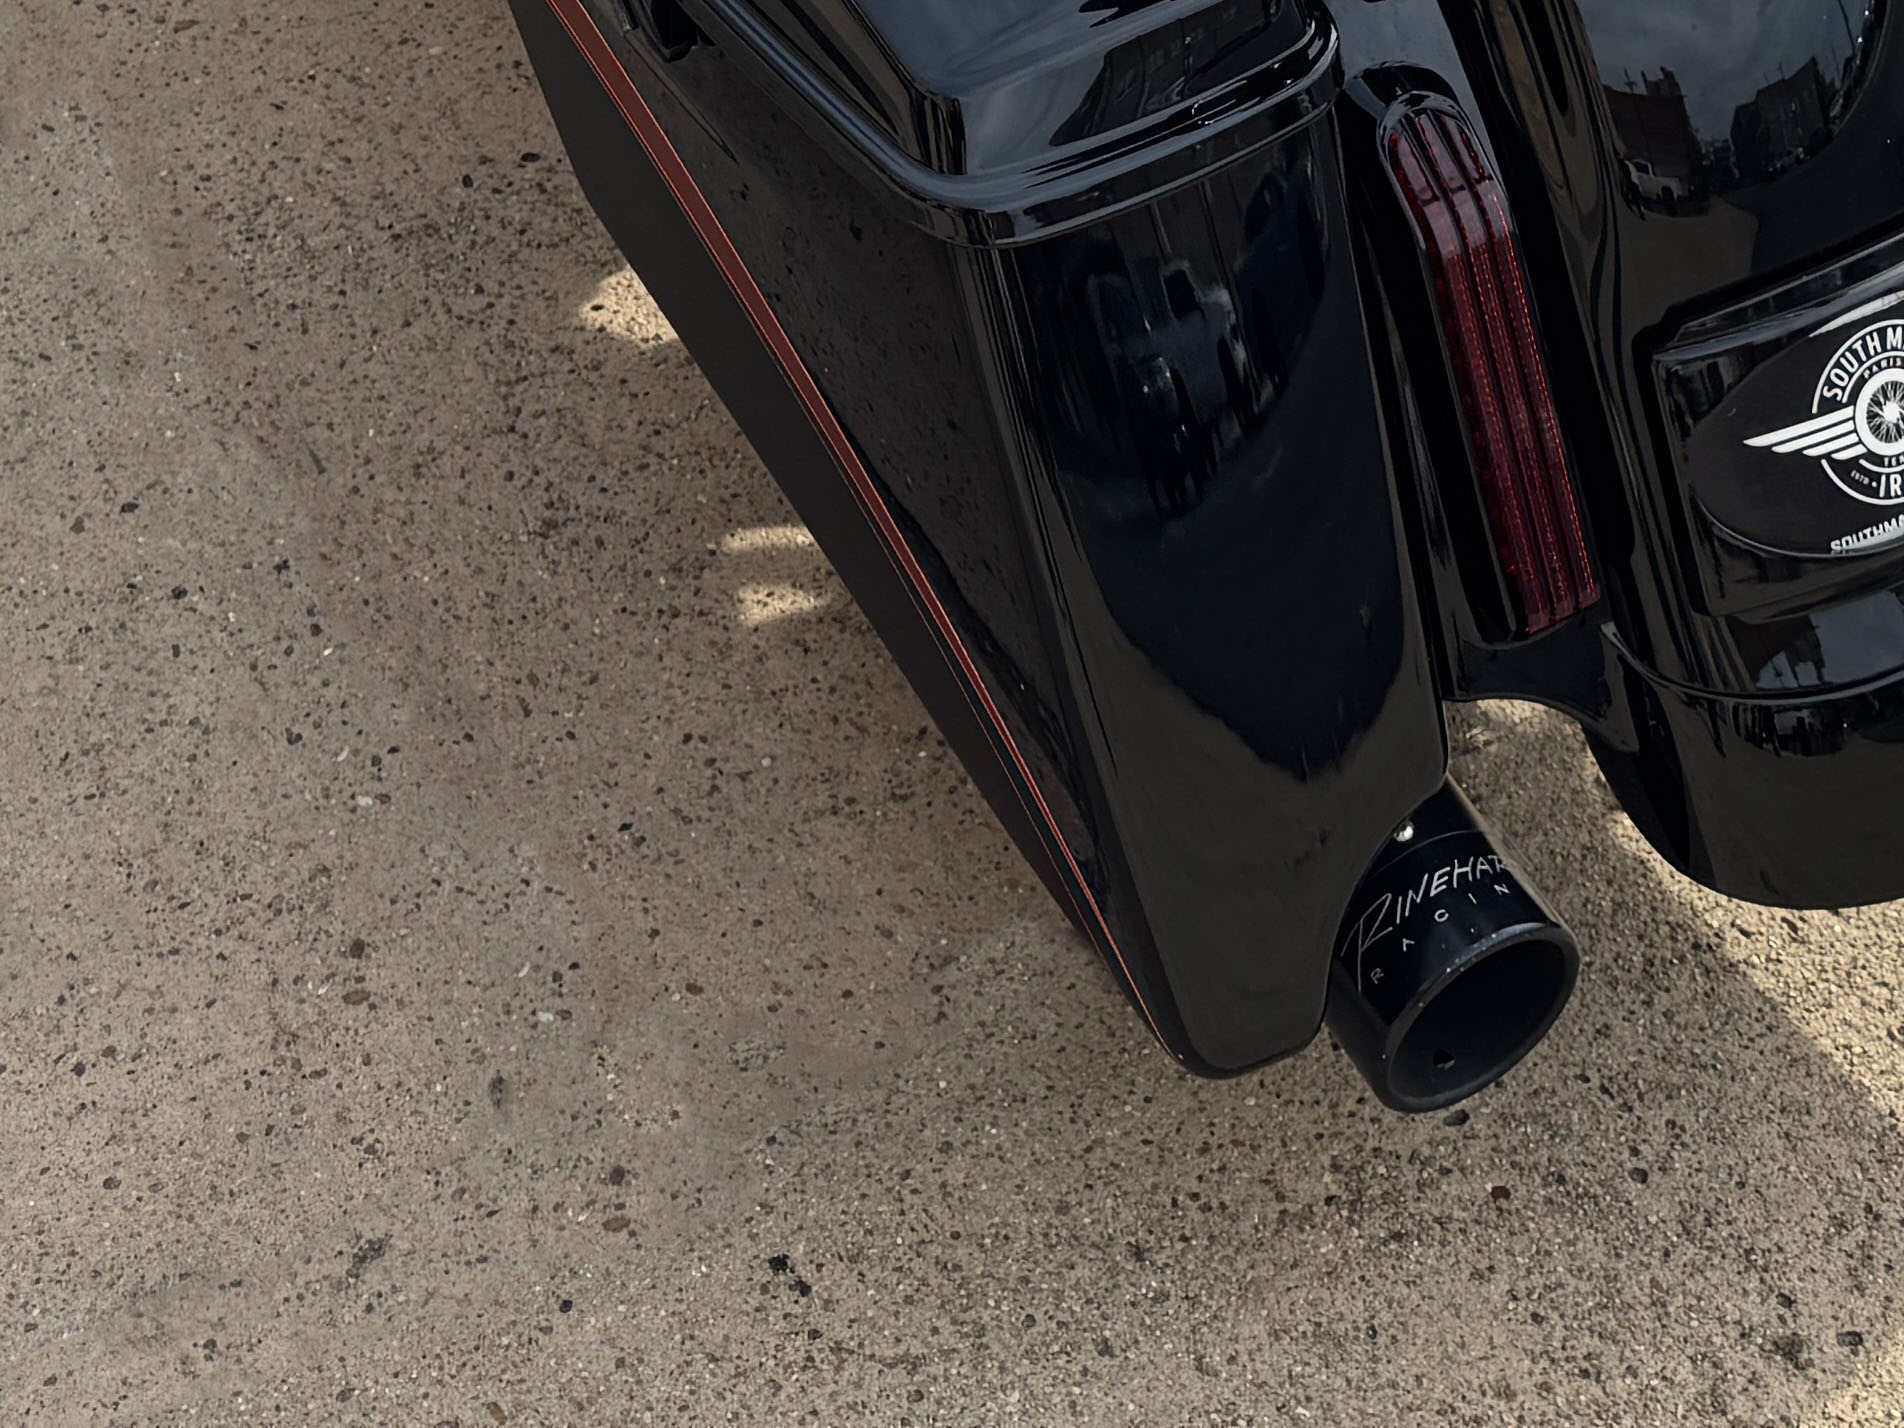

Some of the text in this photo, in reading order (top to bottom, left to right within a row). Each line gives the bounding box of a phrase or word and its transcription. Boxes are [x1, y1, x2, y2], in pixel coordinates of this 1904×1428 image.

[1822, 331, 1882, 402] SOUTH
[1862, 356, 1904, 380] PARIS
[1340, 854, 1506, 994] RINEHAR
